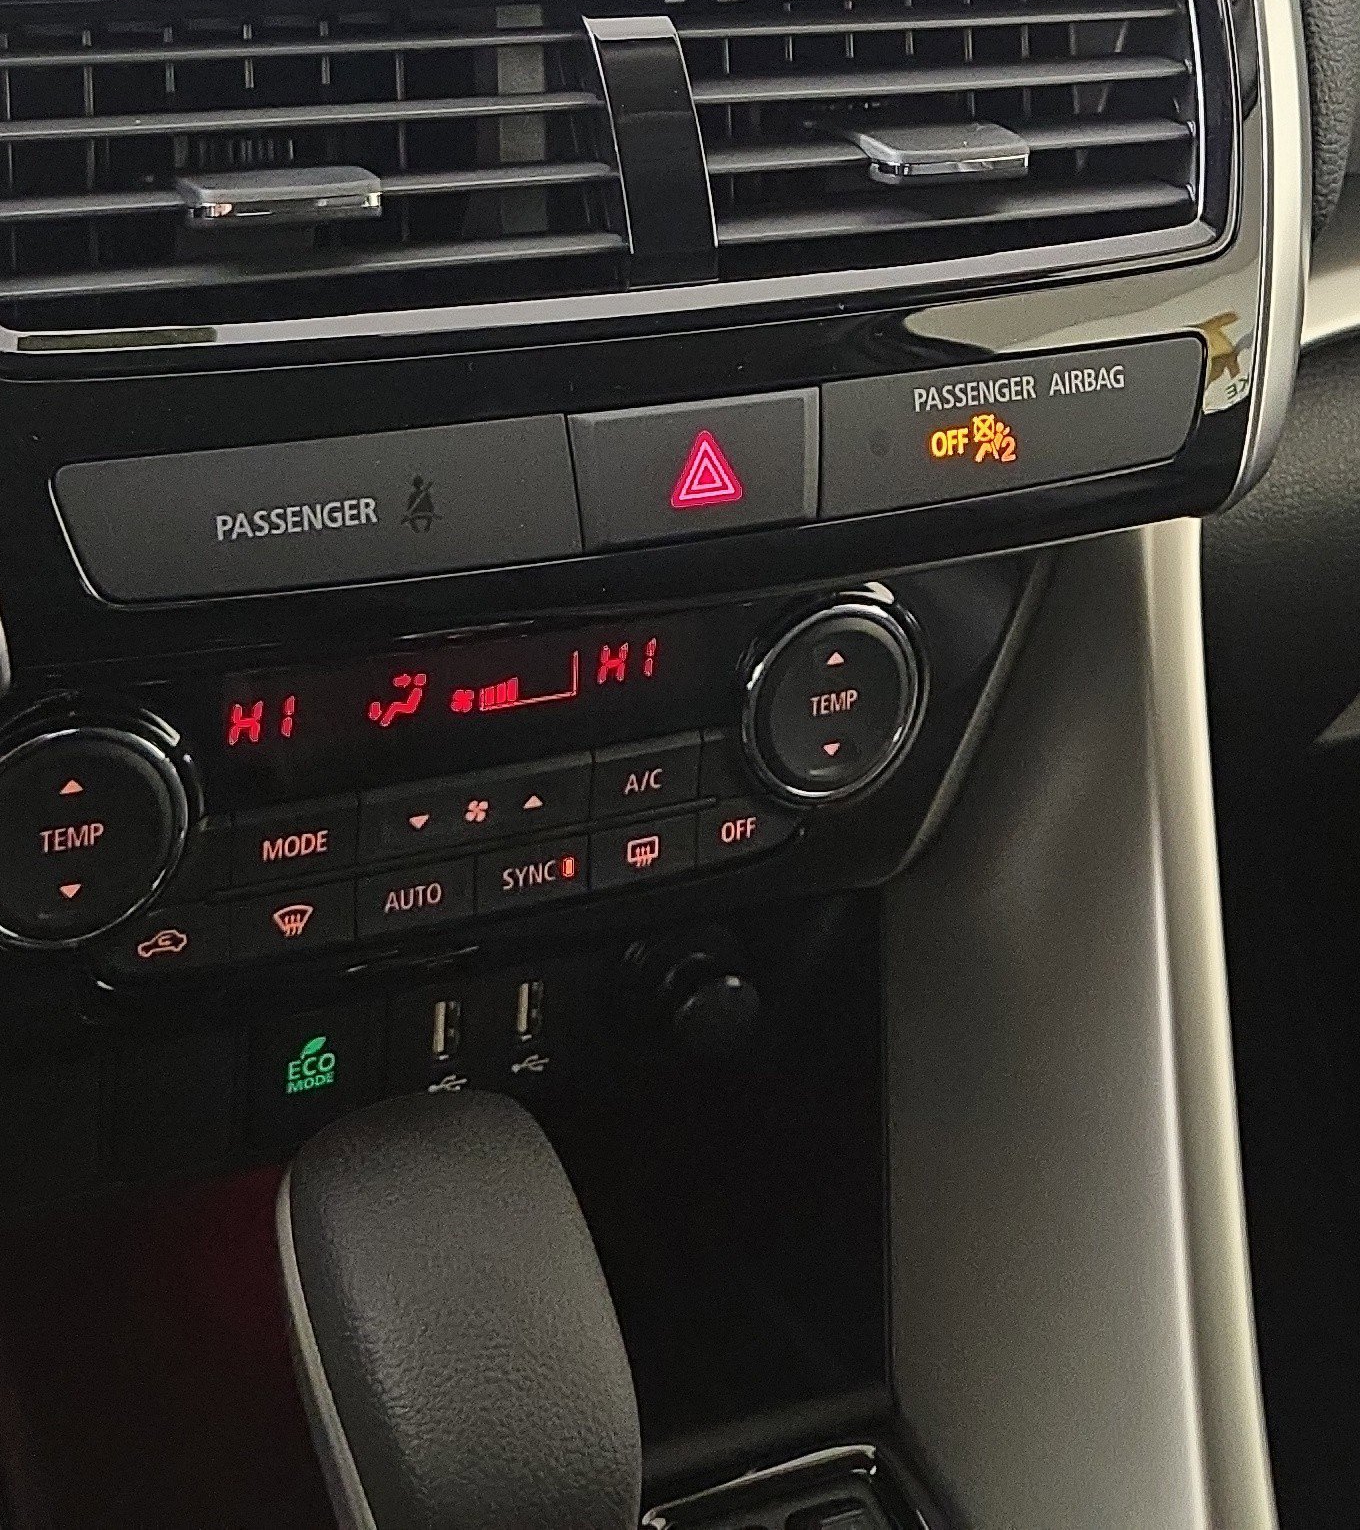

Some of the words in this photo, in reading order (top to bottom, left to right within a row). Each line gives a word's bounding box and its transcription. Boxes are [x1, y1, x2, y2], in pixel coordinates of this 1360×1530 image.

[914, 375, 1037, 413] PASSENGER
[1049, 365, 1126, 397] AIRBAG
[931, 427, 970, 458] OFF
[215, 497, 378, 541] PASSENGER
[597, 637, 658, 684] HI
[810, 688, 858, 718] TEMP
[229, 695, 296, 745] HI
[624, 768, 663, 795] A/C
[40, 822, 104, 854] TEMP
[720, 816, 757, 843] OFF
[262, 830, 329, 863] MODE
[502, 860, 557, 891] SYNC
[384, 884, 442, 914] AUTO
[286, 1070, 335, 1094] MODE
[287, 1052, 336, 1081] ECO
